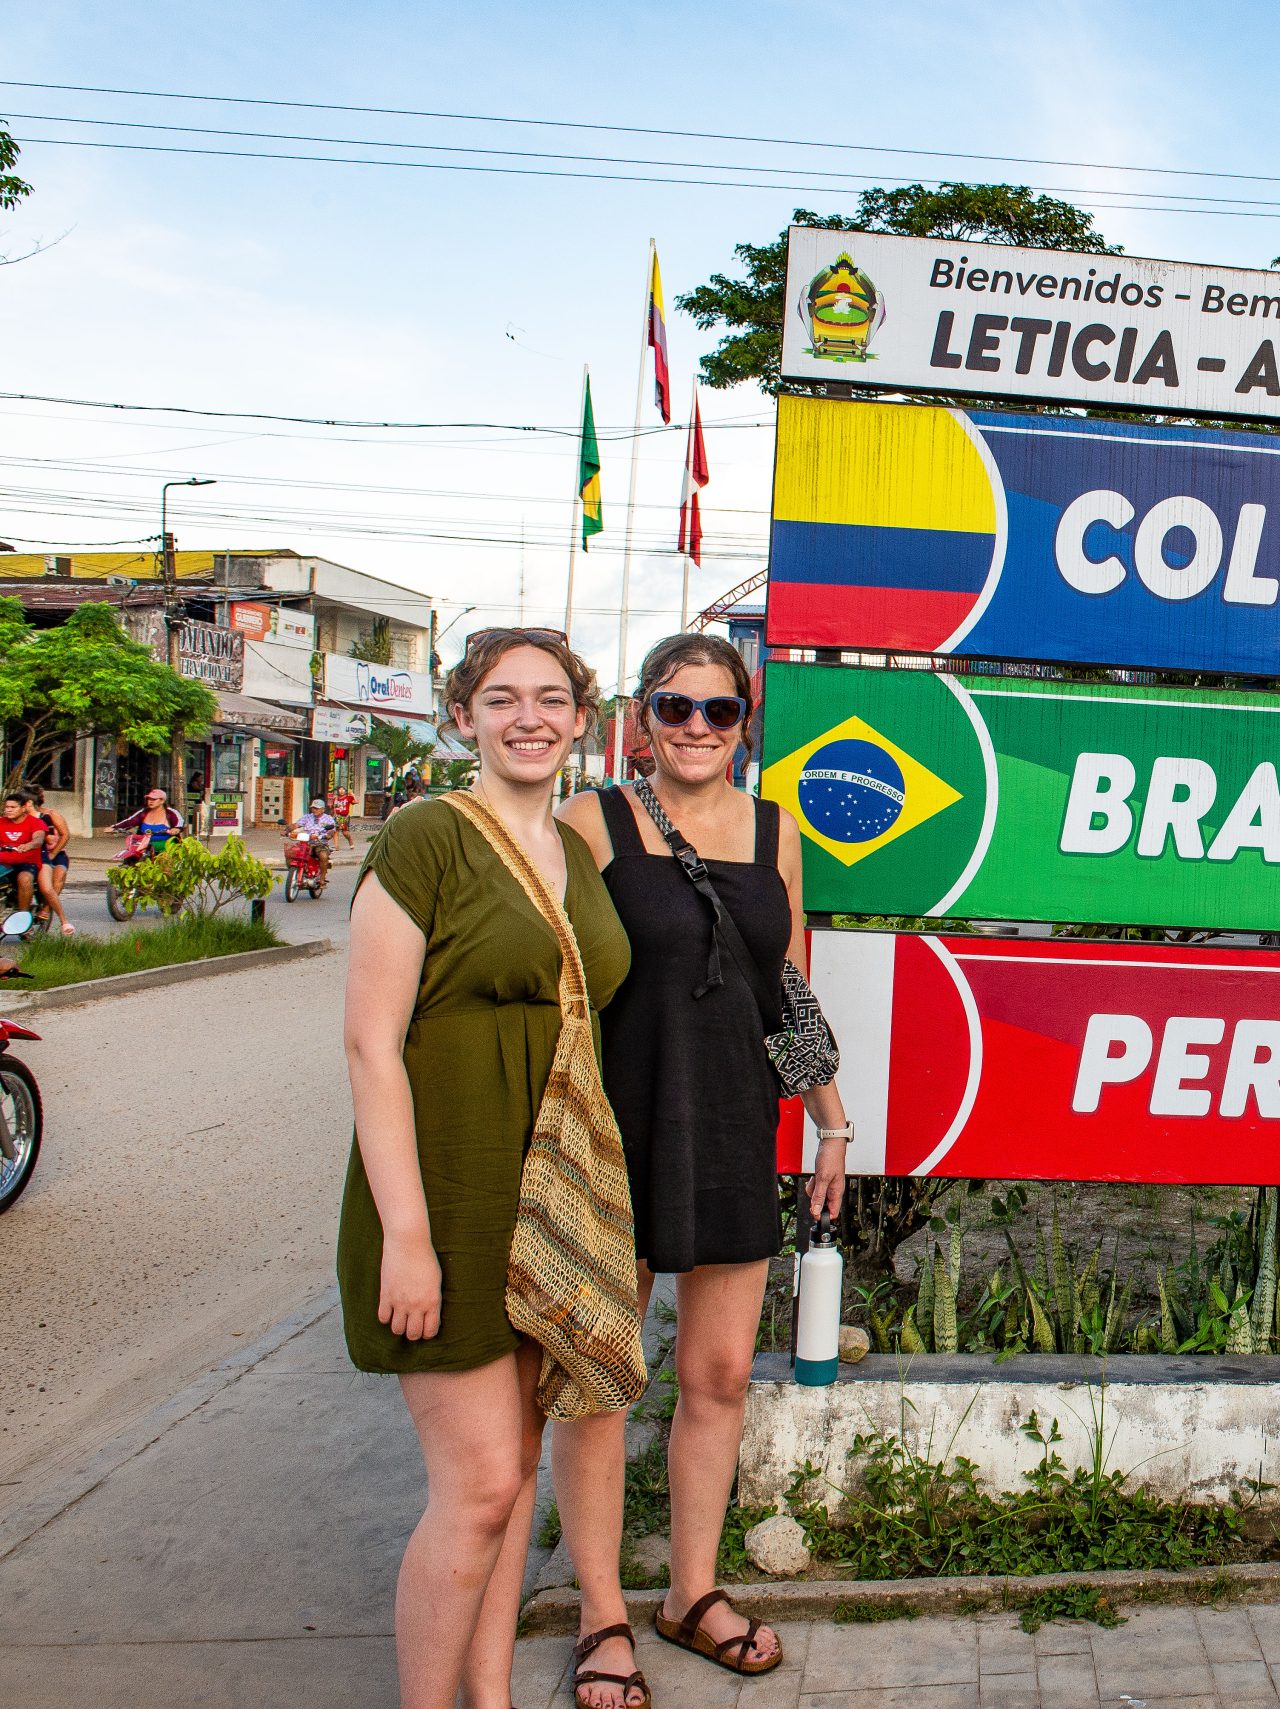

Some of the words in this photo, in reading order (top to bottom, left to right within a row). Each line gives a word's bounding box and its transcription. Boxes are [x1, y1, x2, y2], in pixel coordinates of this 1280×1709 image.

[929, 255, 1164, 308] Bienvenidos
[929, 310, 1180, 388] LETICIA
[804, 771, 837, 779] ORDEM
[841, 773, 848, 781] E
[851, 775, 904, 802] PROGRESSO
